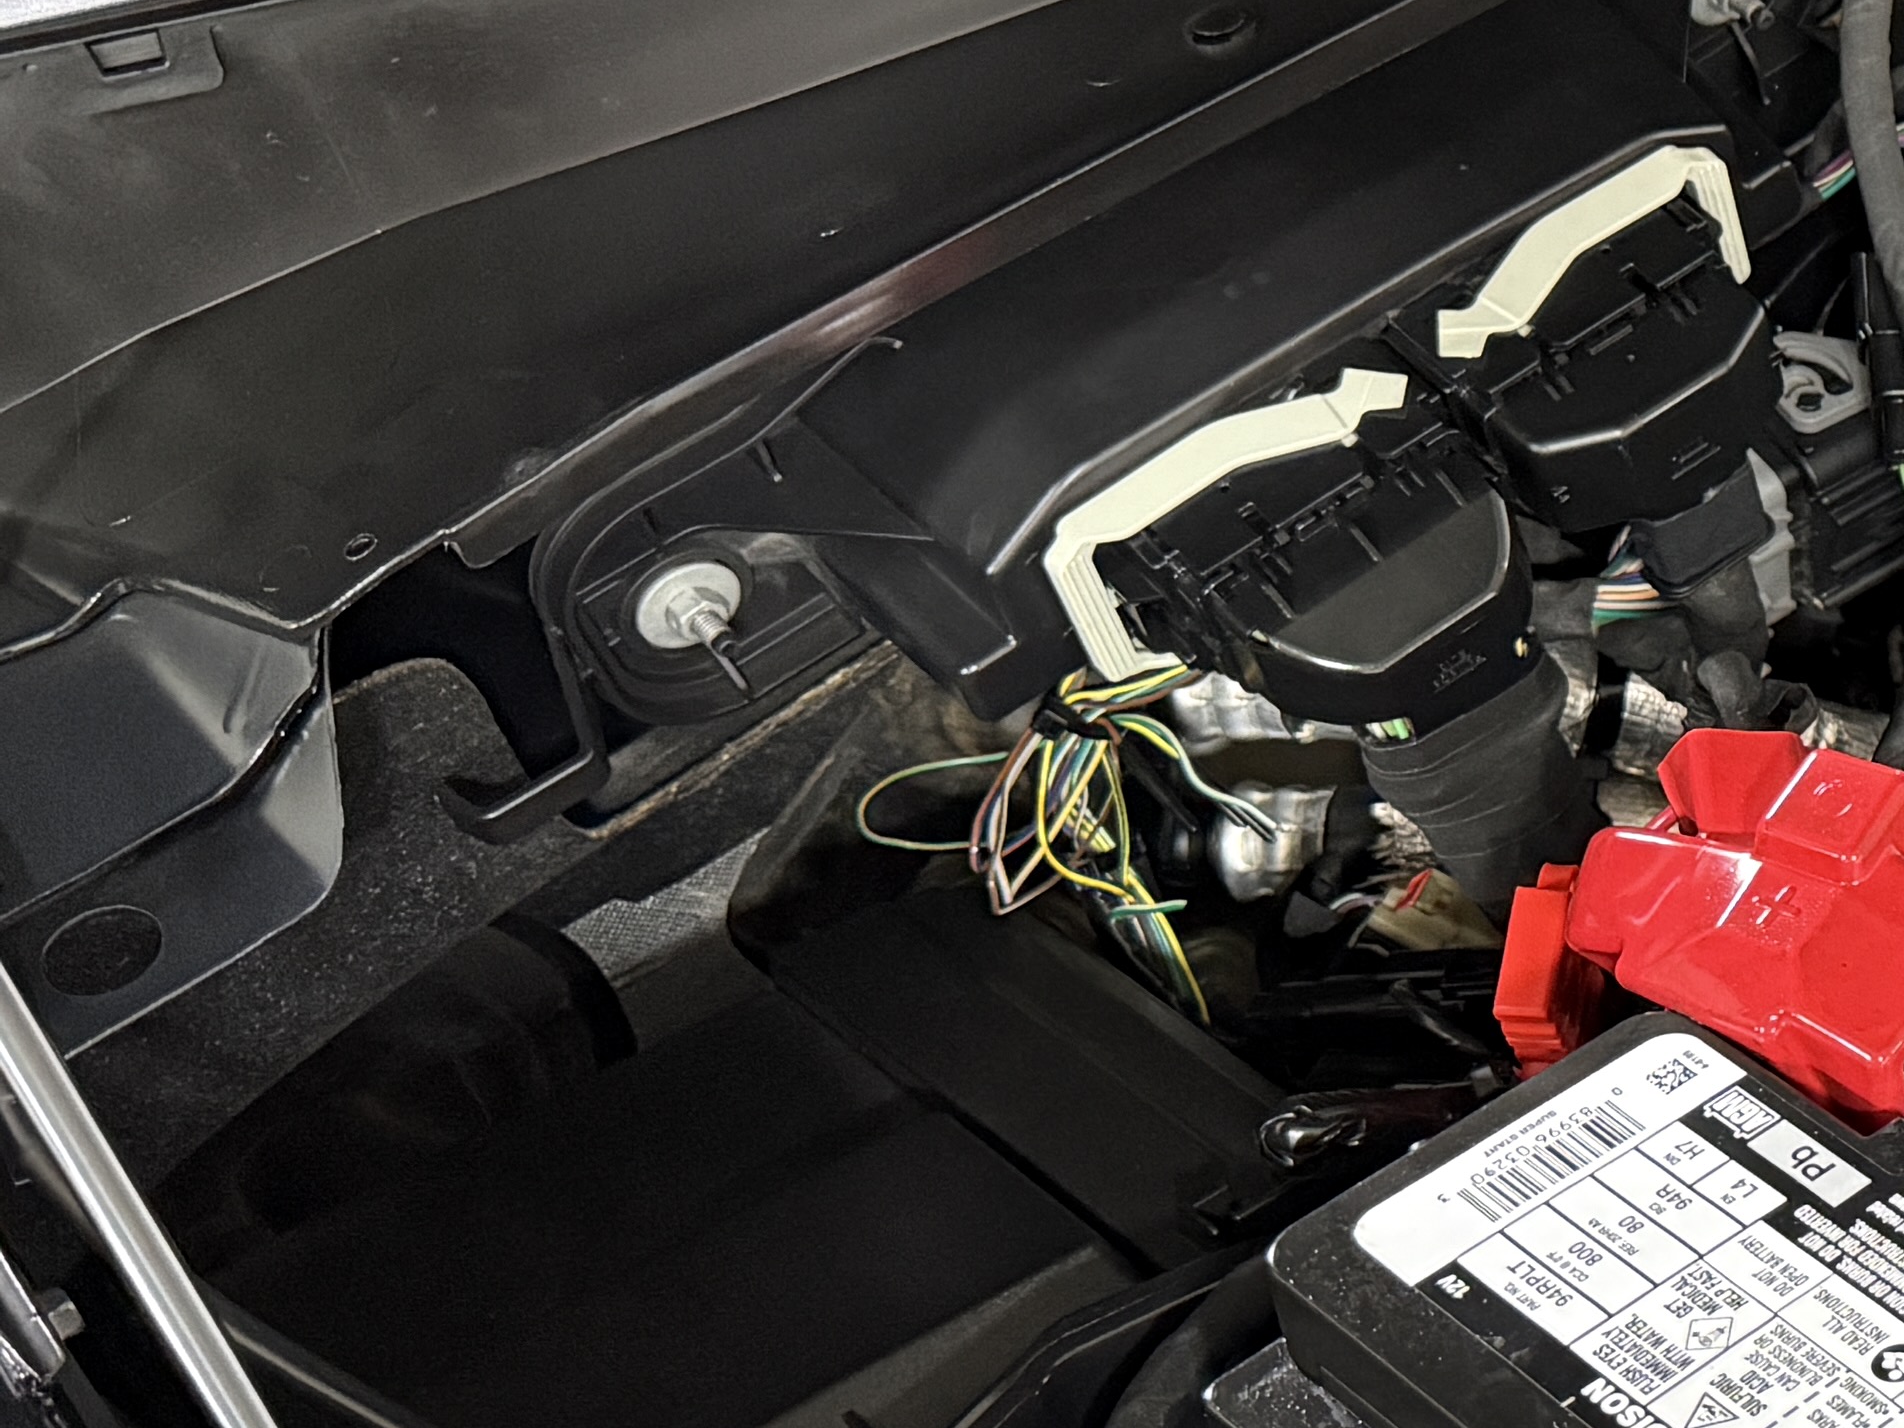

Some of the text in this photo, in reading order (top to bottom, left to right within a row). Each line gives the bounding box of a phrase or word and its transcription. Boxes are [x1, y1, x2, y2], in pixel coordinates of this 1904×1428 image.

[1535, 1107, 1594, 1143] 83996
[1708, 1088, 1776, 1135] AGM
[1470, 1145, 1531, 1187] 03290
[1674, 1141, 1706, 1161] H7
[1791, 1146, 1837, 1182] Pb
[1656, 1184, 1693, 1211] 94R
[1730, 1179, 1759, 1199] L4
[1618, 1216, 1645, 1234] 80
[1568, 1241, 1604, 1267] 800
[1738, 1235, 1810, 1287] OPEN BATTERY
[1436, 1274, 1471, 1299] 12V
[1506, 1261, 1574, 1307] 94RPLT
[1671, 1276, 1724, 1317] MEDICAL
[1714, 1288, 1750, 1312] HELP
[1751, 1268, 1795, 1298] DO NOT
[1663, 1298, 1695, 1319] GET
[1822, 1315, 1875, 1357] READ ALL
[1592, 1344, 1662, 1396] FLUSH EYES
[1601, 1326, 1679, 1384] IMMEDIATELY
[1660, 1344, 1696, 1372] WITH
[1744, 1349, 1801, 1392] CAN CAUSE
[1753, 1334, 1824, 1387] BLINDNESS OR
[1800, 1347, 1842, 1378] SEVERE
[1709, 1373, 1768, 1417] SULFURIC
[1739, 1370, 1775, 1395] ACID
